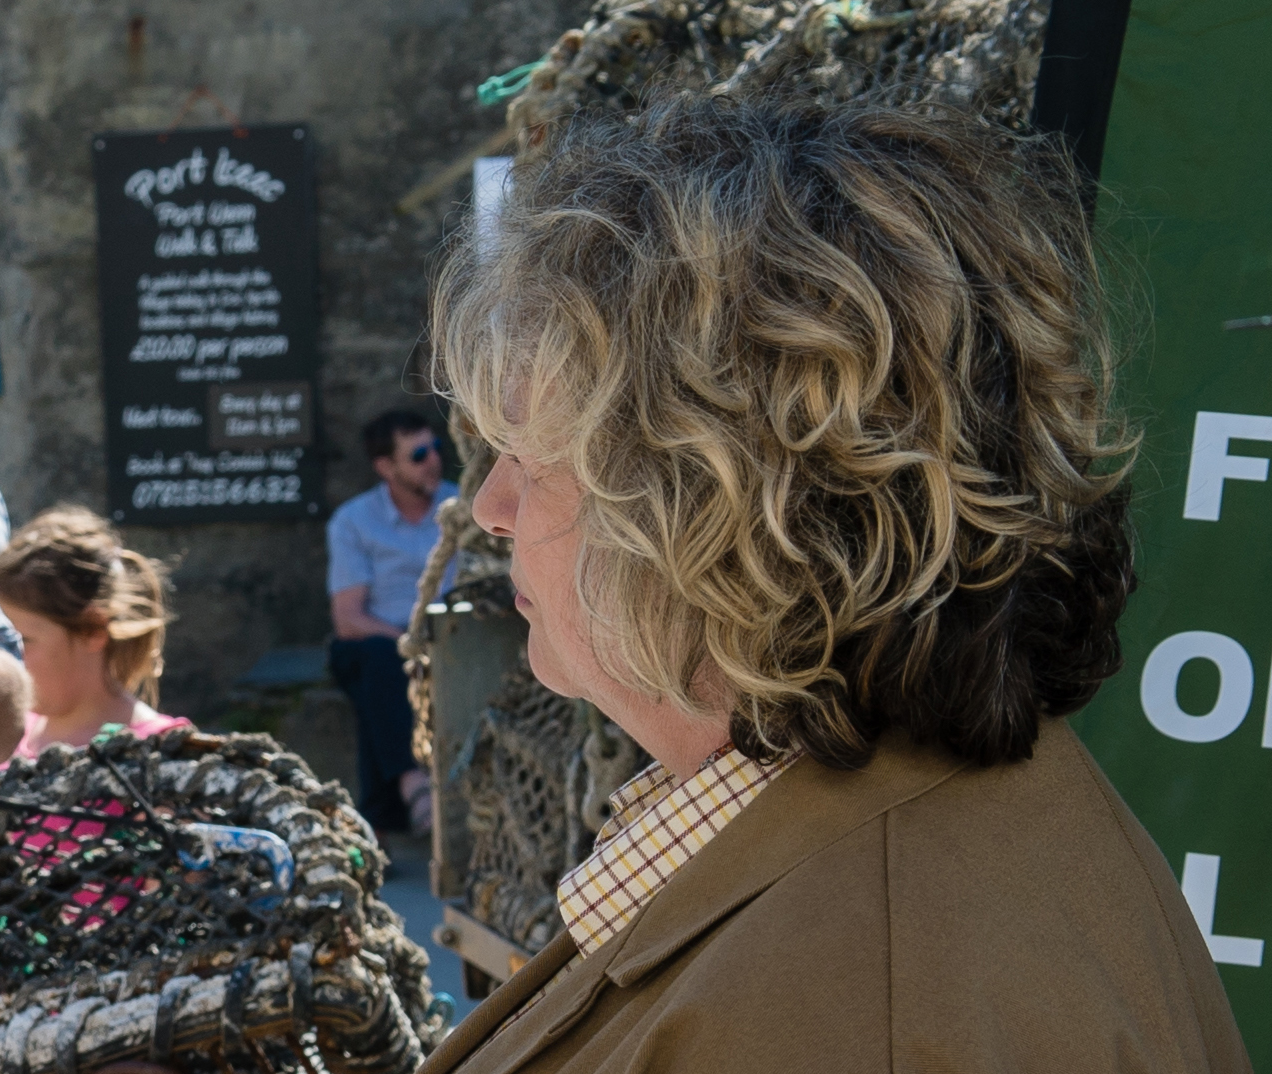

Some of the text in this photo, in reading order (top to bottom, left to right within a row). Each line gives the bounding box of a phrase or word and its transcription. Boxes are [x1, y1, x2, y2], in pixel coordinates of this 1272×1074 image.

[124, 146, 207, 209] Port
[155, 199, 205, 228] Port
[200, 229, 218, 256] &
[220, 223, 259, 255] Talk
[194, 337, 229, 366] per
[227, 334, 289, 365] person
[1140, 630, 1272, 749] O
[1182, 852, 1264, 967] L
